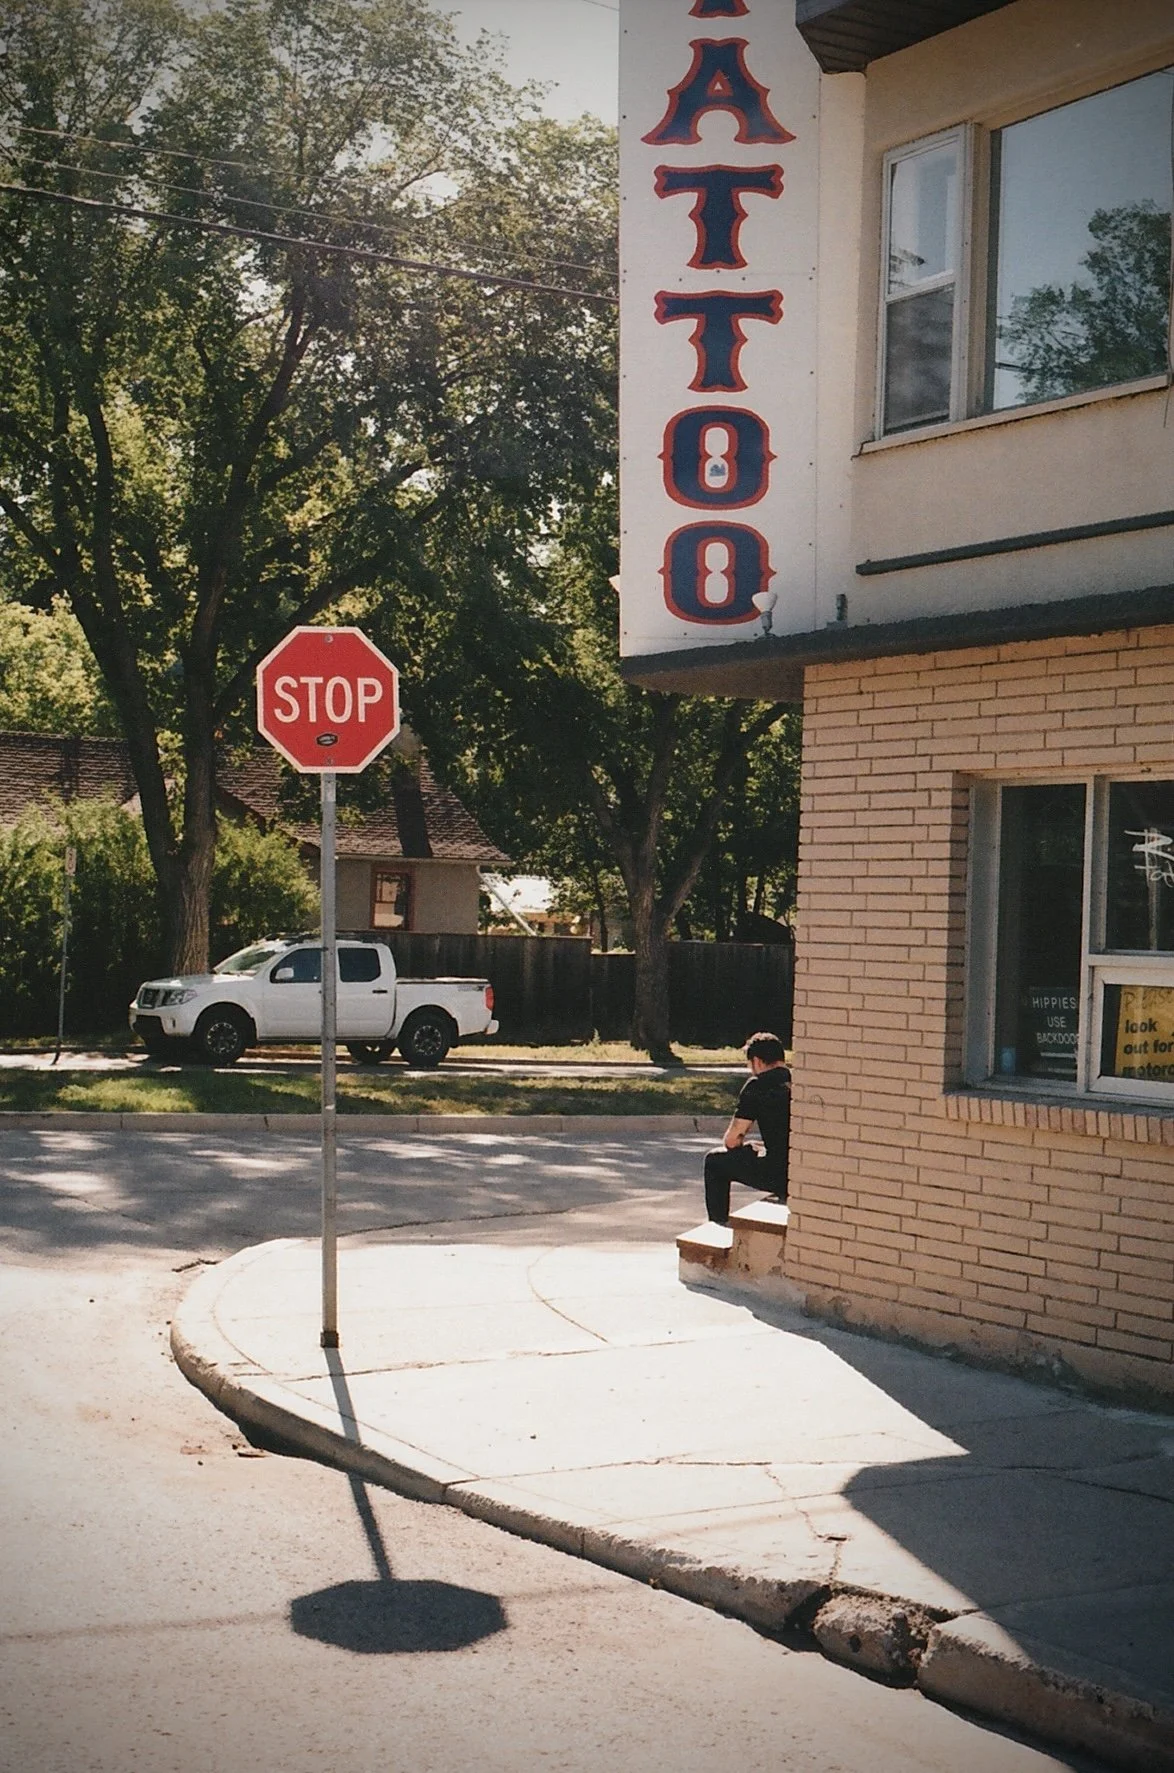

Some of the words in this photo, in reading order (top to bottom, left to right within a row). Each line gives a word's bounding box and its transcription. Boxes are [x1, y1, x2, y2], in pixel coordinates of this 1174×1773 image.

[641, 0, 797, 625] ATTOO
[274, 676, 383, 723] STOP
[1032, 996, 1077, 1010] HIPPIES
[1047, 1016, 1067, 1028] USE
[1125, 1018, 1158, 1034] look
[1036, 1032, 1080, 1045] BACKDOO
[1123, 1040, 1149, 1055] out
[1153, 1039, 1174, 1054] for
